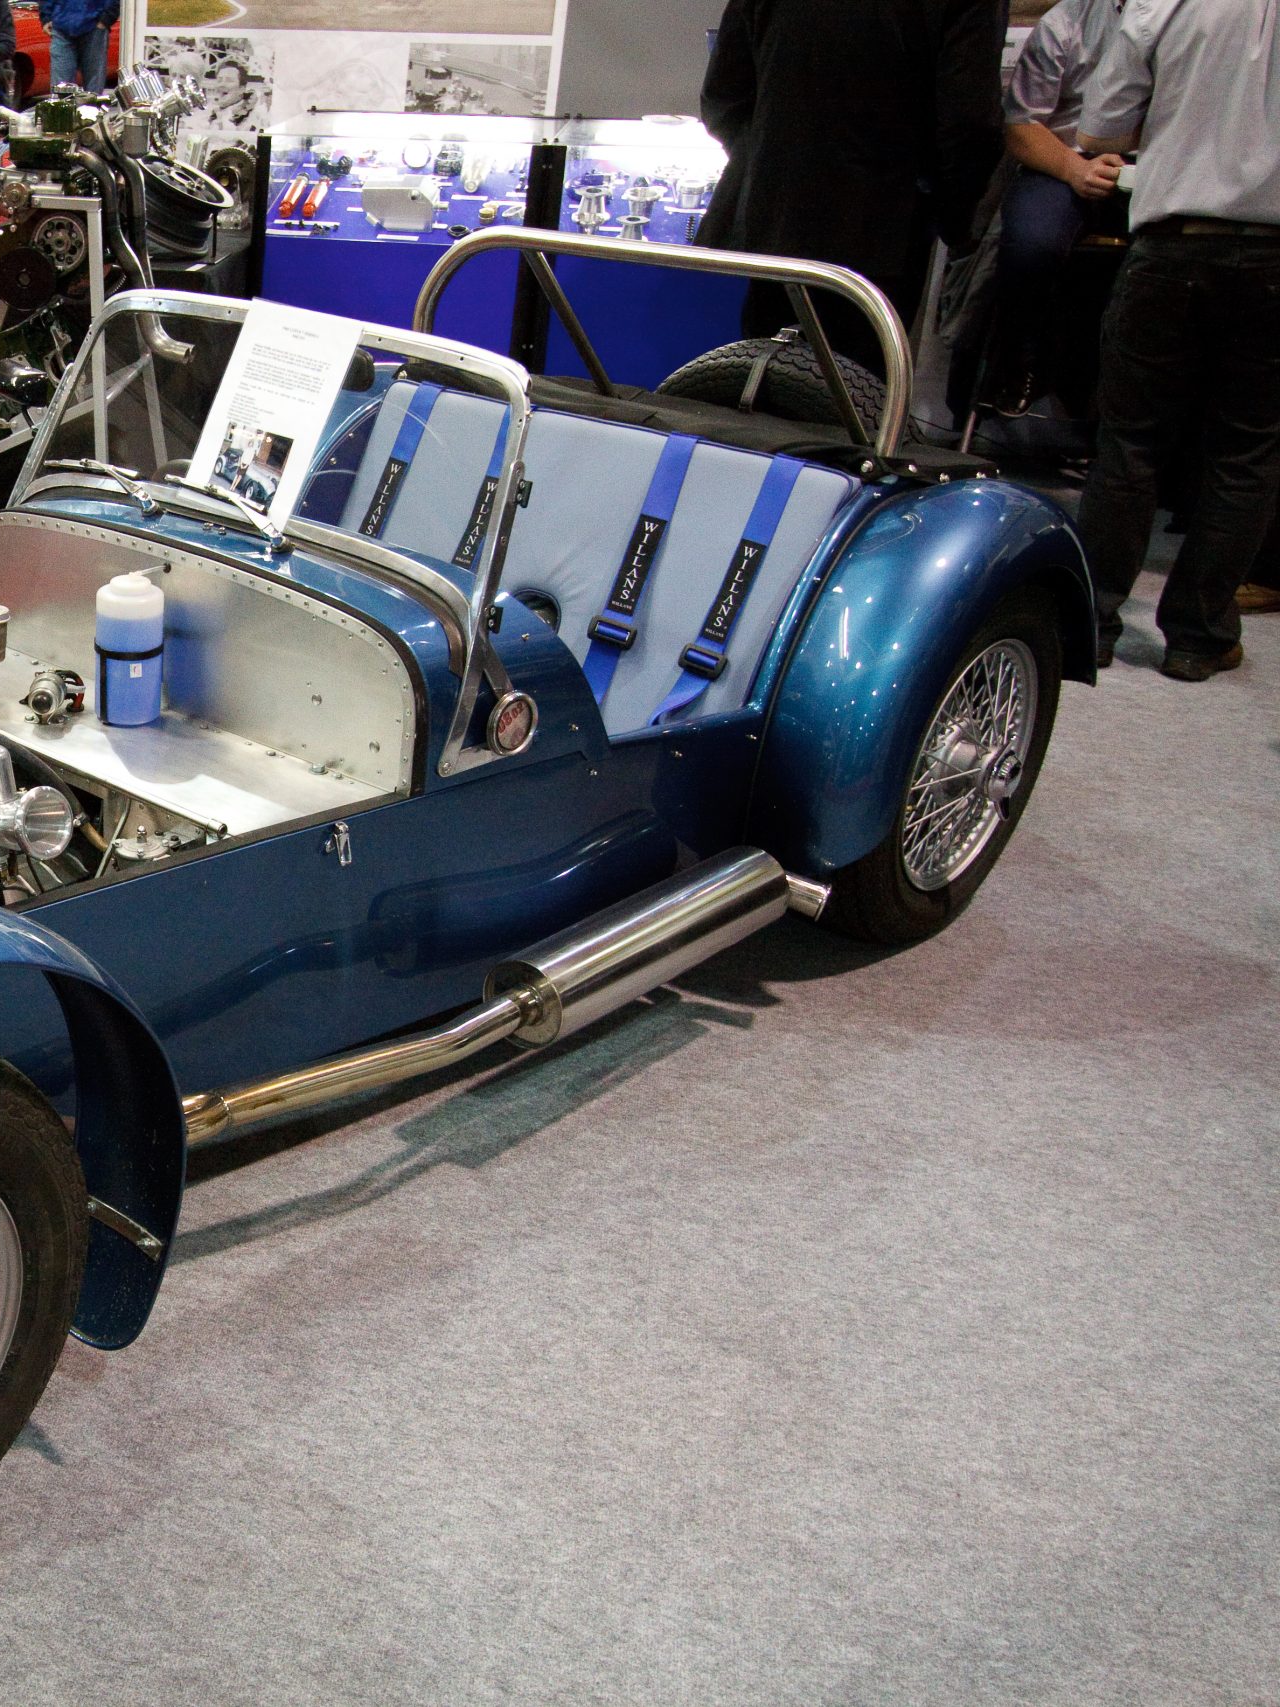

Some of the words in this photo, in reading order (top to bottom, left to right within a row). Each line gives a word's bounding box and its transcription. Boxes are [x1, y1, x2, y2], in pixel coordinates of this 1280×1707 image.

[366, 463, 402, 536] WILLANS
[462, 481, 498, 556] WILLANS
[620, 521, 659, 601] WILLANS
[713, 545, 758, 628] WILLANS
